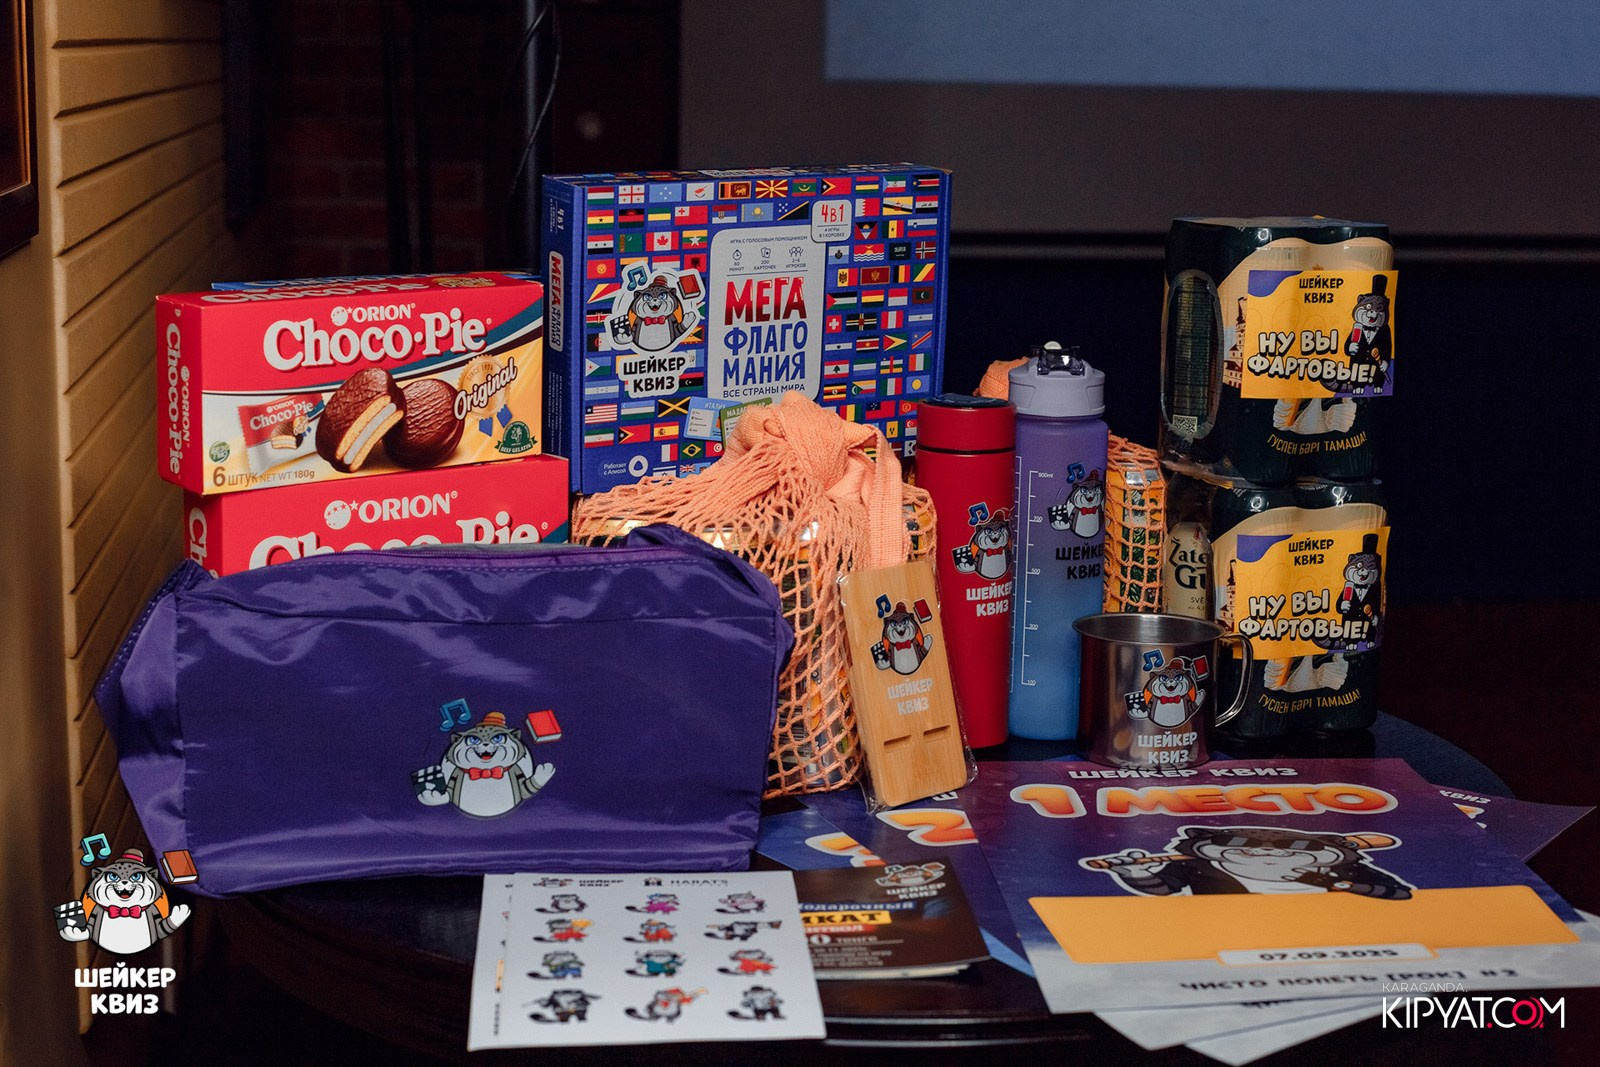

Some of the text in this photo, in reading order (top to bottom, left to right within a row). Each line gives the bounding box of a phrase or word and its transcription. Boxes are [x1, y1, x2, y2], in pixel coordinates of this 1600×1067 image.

[551, 255, 561, 306] МЕГА
[1299, 275, 1344, 290] ШЕЙКЕР
[724, 276, 807, 326] МЕГА
[1304, 292, 1334, 304] КВИЗ
[352, 304, 412, 323] ORION
[723, 321, 808, 357] ФЛАГО
[1258, 329, 1339, 356] НУ ВЫ
[466, 366, 480, 381] SINCE
[623, 356, 686, 376] ШЕЙКЕР
[723, 351, 806, 388] МАНИЯ
[1248, 353, 1378, 384] ФАРТОВЫЕ!
[454, 356, 518, 420] Original
[633, 376, 675, 393] КВИЗ
[723, 383, 806, 399] ВСЕ СТРАНЫ МИРА
[182, 384, 191, 442] ORION
[1267, 433, 1298, 455] ГУСПЕН
[1323, 431, 1368, 452] ТАМАША!
[212, 466, 226, 487] 6
[259, 473, 276, 482] NET
[278, 471, 292, 480] WT
[294, 470, 315, 479] 180g
[358, 493, 450, 523] ORION
[1056, 542, 1104, 561] ШЕЙКЕ
[1288, 539, 1335, 553] ШЕЙКЕР
[1294, 554, 1325, 567] КВИЗ
[1067, 563, 1101, 580] КВИЗ
[976, 599, 1009, 617] КВИЗ
[1248, 588, 1330, 620] НУ ВЫ
[1238, 616, 1370, 641] ФАРТОВЫЕ!
[887, 677, 933, 700] ШЕЙКЕР
[897, 697, 929, 715] КВИЗ
[1258, 693, 1289, 714] ГУСПЕН
[1316, 688, 1361, 708] ТАМАША!
[1137, 731, 1198, 748] ШЕЙКЕР
[1148, 750, 1190, 764] КВИЗ
[1068, 767, 1299, 779] ШЕЙКЕР КВИЗ
[1010, 784, 1399, 818] 1 МЕСТО
[886, 882, 946, 896] ШЕЙКЕР
[898, 889, 938, 900] КВИЗ
[1258, 949, 1399, 961] 07.09.2025
[1179, 979, 1269, 991] ЧИСТО
[1278, 974, 1378, 987] ПОПЕТЬ
